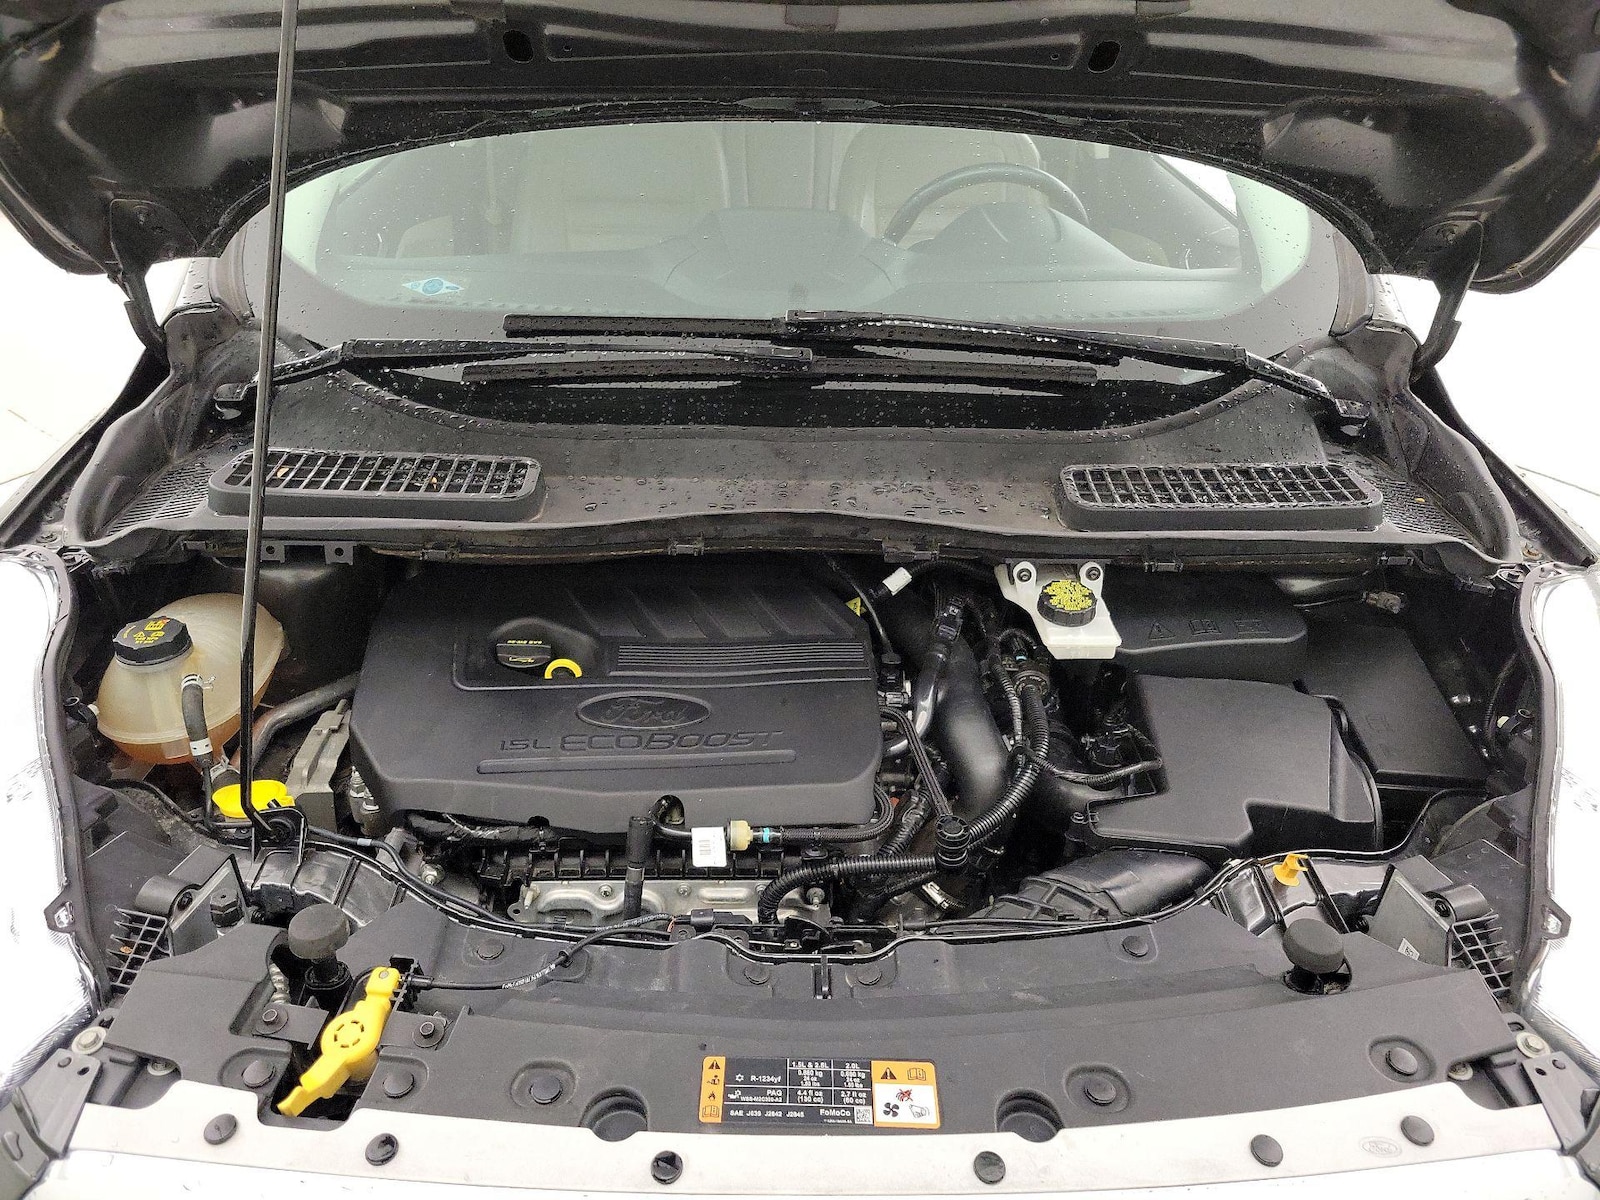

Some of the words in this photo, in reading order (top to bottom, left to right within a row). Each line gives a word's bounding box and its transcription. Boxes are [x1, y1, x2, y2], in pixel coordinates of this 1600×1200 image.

[601, 699, 691, 724] Ford
[500, 738, 550, 751] 1.5L
[560, 731, 784, 751] ECOBOOST
[815, 1070, 823, 1078] kg
[858, 1071, 866, 1079] kg
[750, 1075, 782, 1083] R-1234yf
[840, 1090, 850, 1098] 2.7
[813, 1096, 824, 1104] cc)
[729, 1109, 744, 1117] SAE
[820, 1108, 851, 1117] FoMoCo
